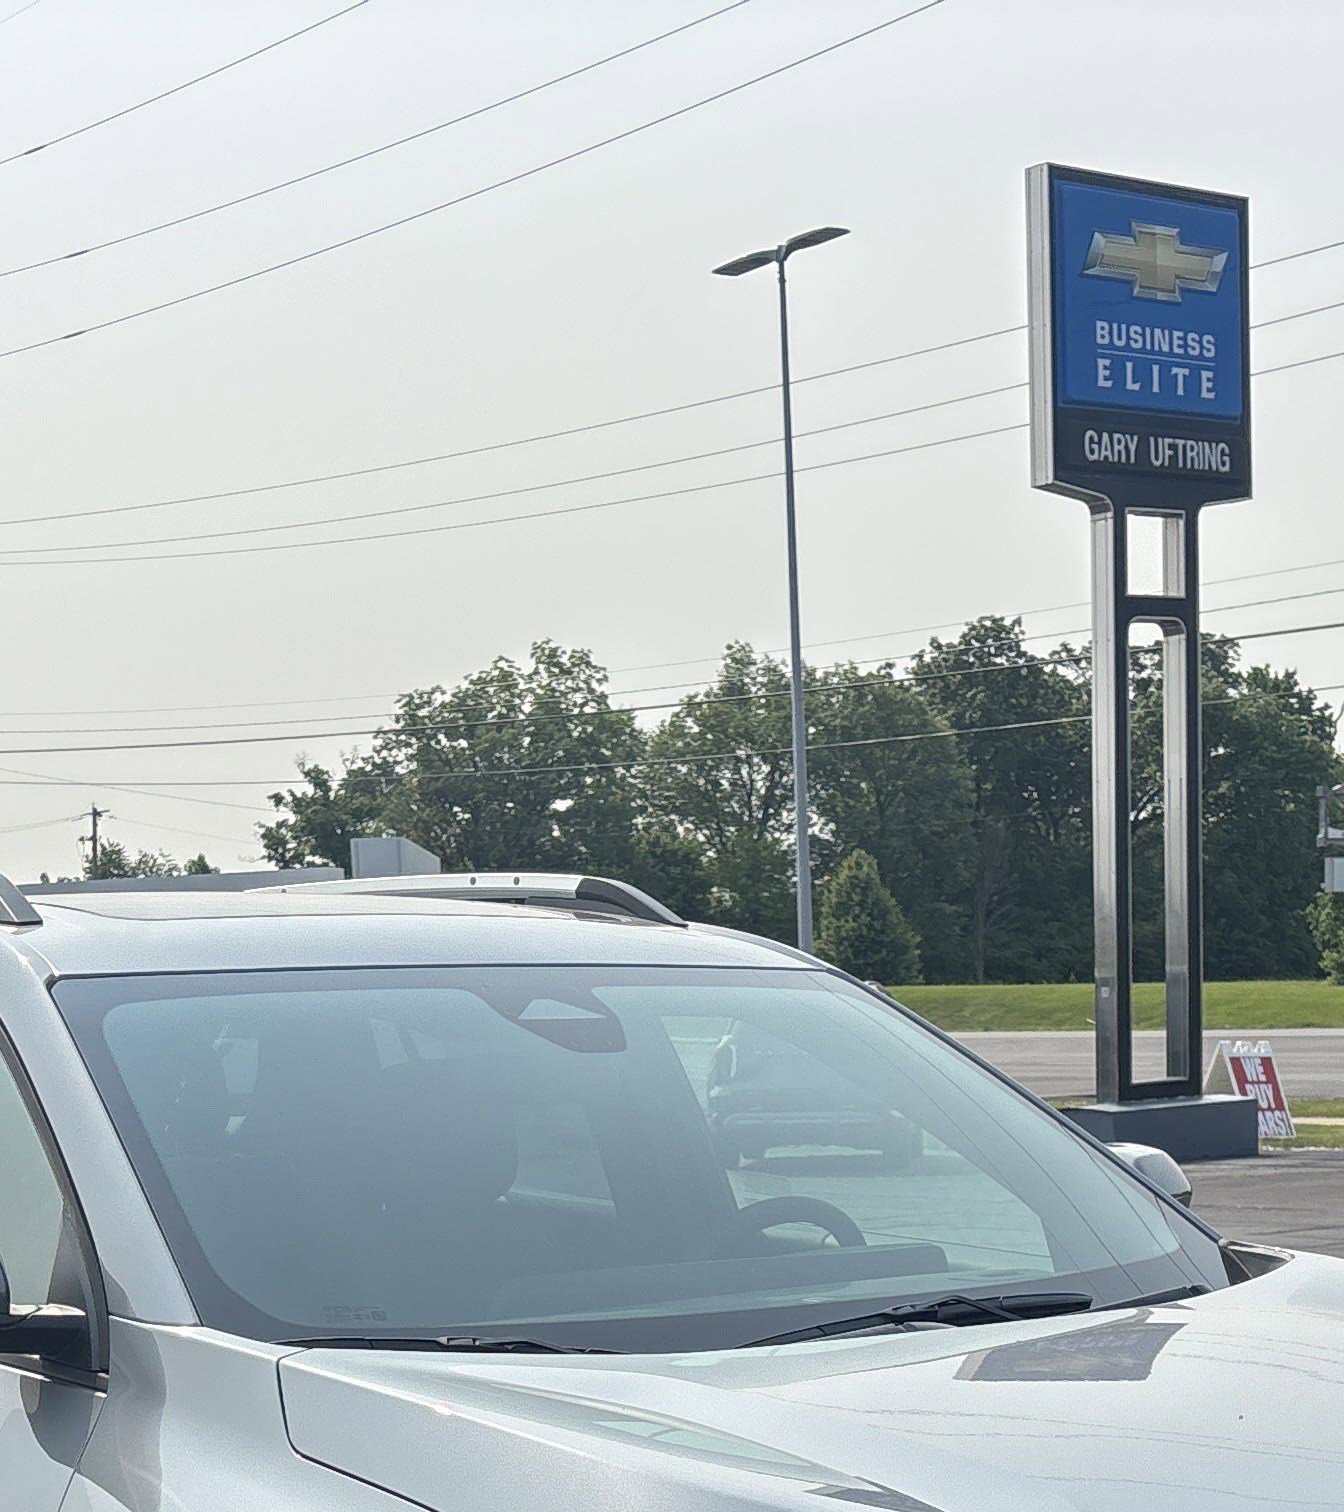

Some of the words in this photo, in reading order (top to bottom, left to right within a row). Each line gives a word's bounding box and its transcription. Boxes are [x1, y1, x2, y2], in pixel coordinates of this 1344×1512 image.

[1095, 320, 1216, 357] BUSINESS
[1096, 358, 1216, 399] ELITE
[1084, 429, 1139, 464] GARY
[1149, 436, 1231, 472] UFTRING
[1240, 1056, 1267, 1082] WE
[1257, 1110, 1293, 1136] ARS!
